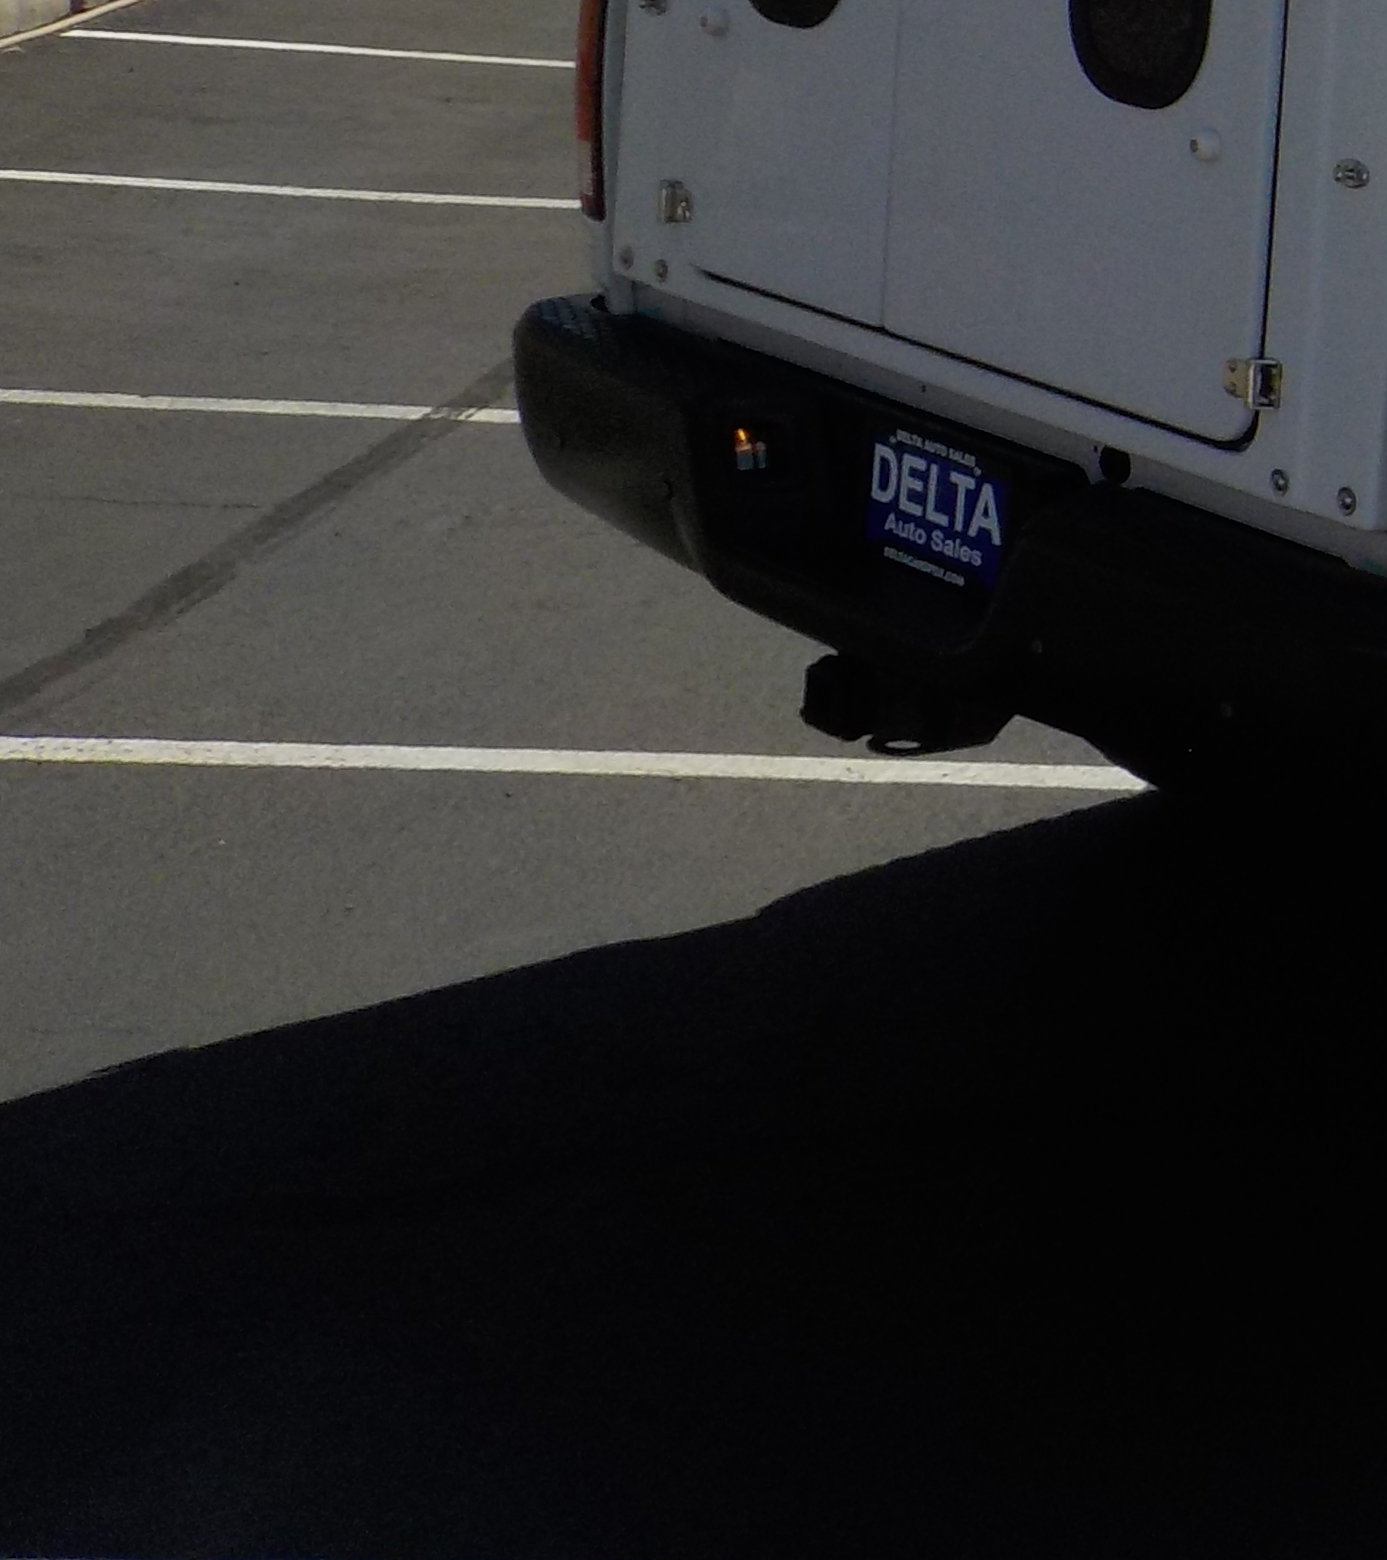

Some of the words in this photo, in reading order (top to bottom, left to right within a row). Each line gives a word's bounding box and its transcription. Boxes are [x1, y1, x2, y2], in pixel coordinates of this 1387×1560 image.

[870, 442, 1002, 546] DELTA
[884, 512, 927, 545] Auto
[930, 528, 982, 567] Sales
